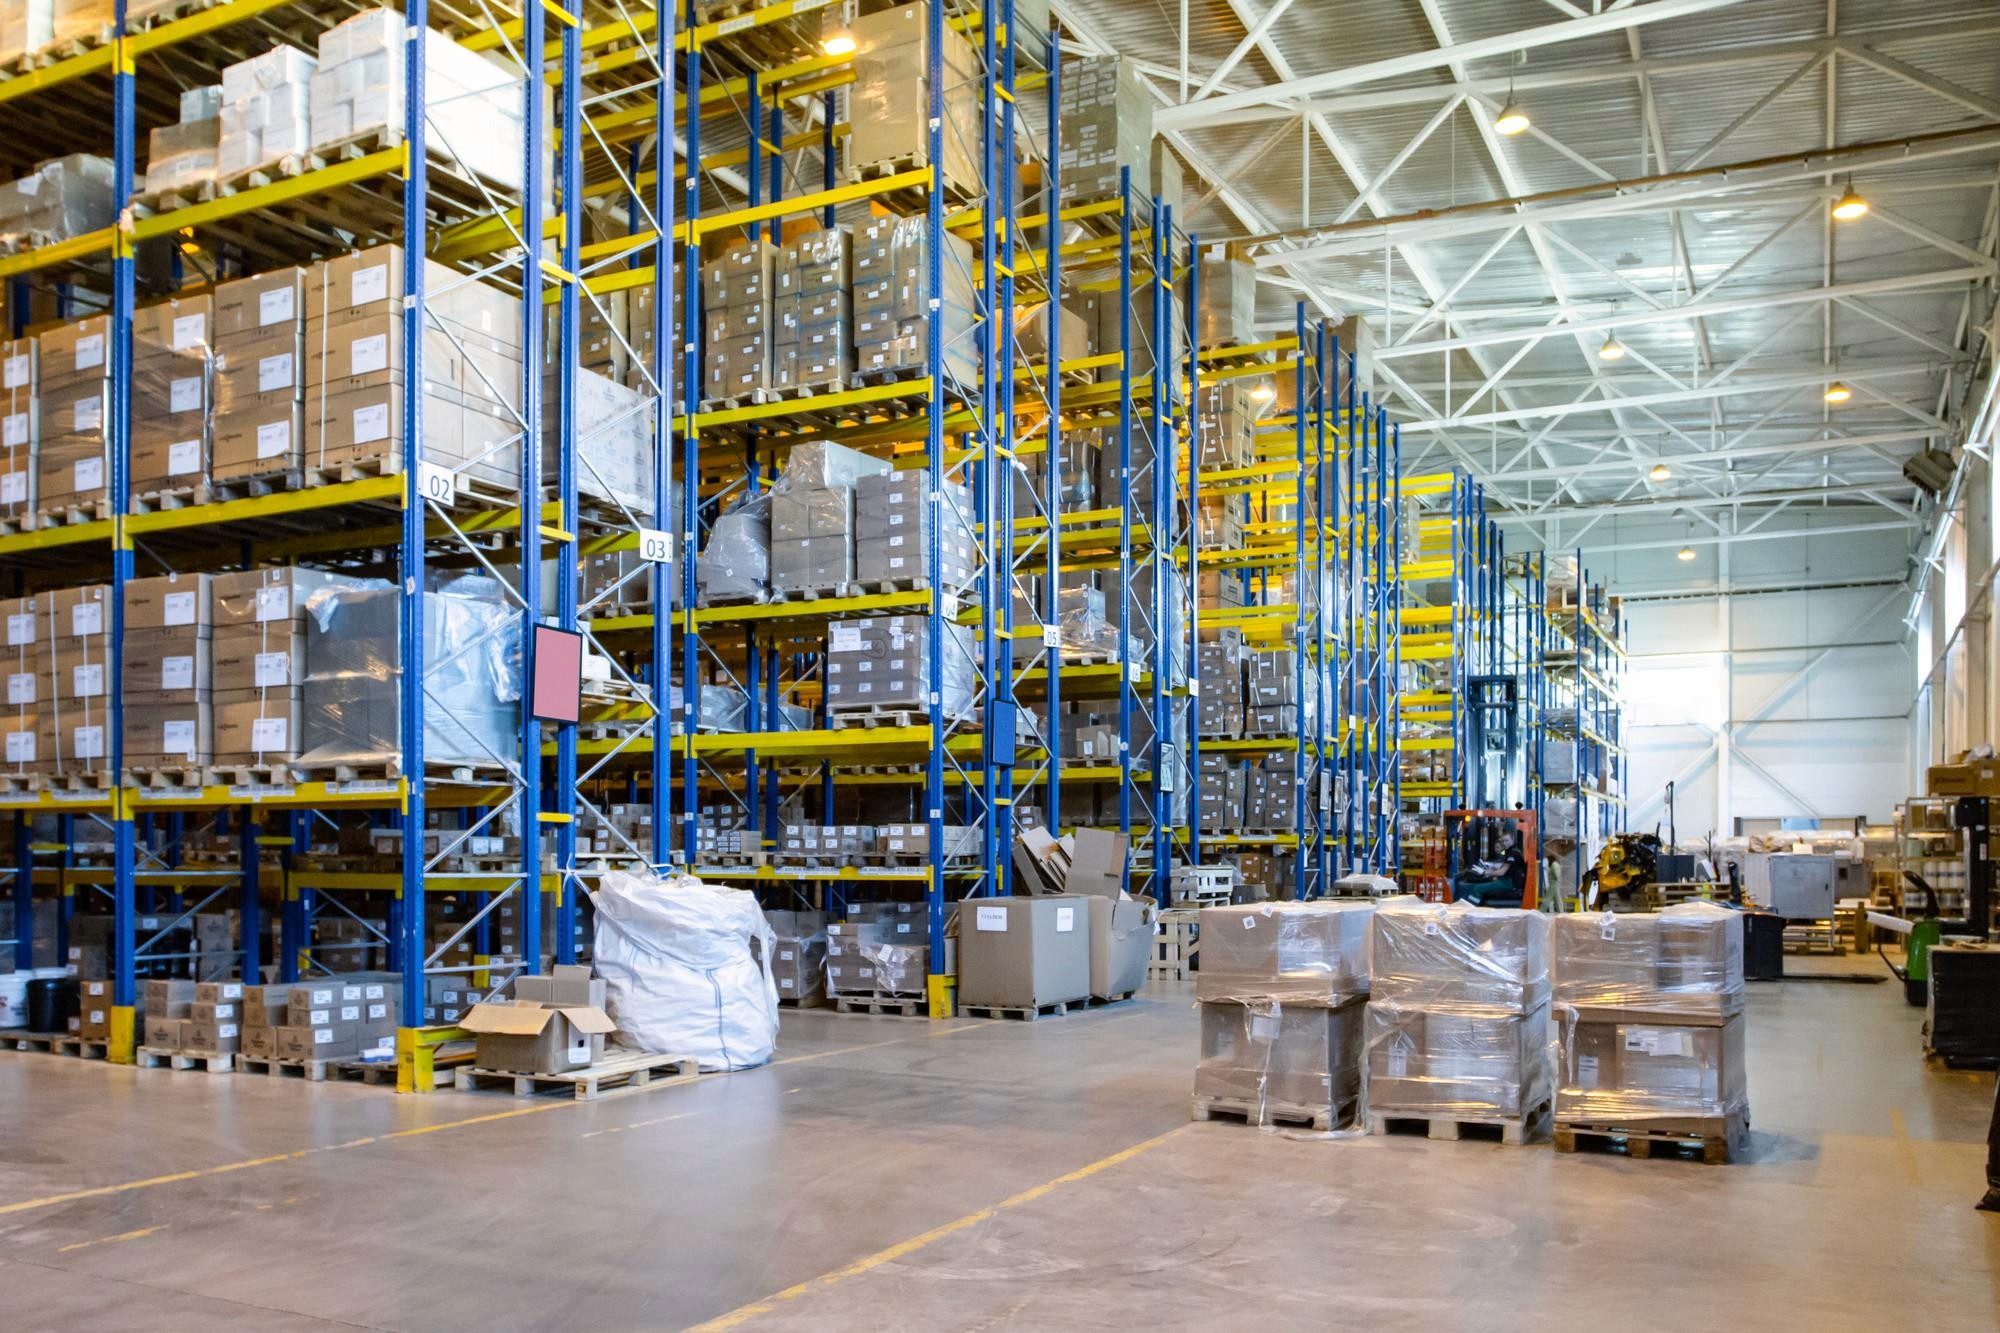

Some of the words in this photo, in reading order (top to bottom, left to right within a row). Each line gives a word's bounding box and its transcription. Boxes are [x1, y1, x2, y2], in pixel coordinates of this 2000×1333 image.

[430, 475, 450, 502] 02
[646, 538, 666, 559] 03
[1047, 631, 1057, 645] 05
